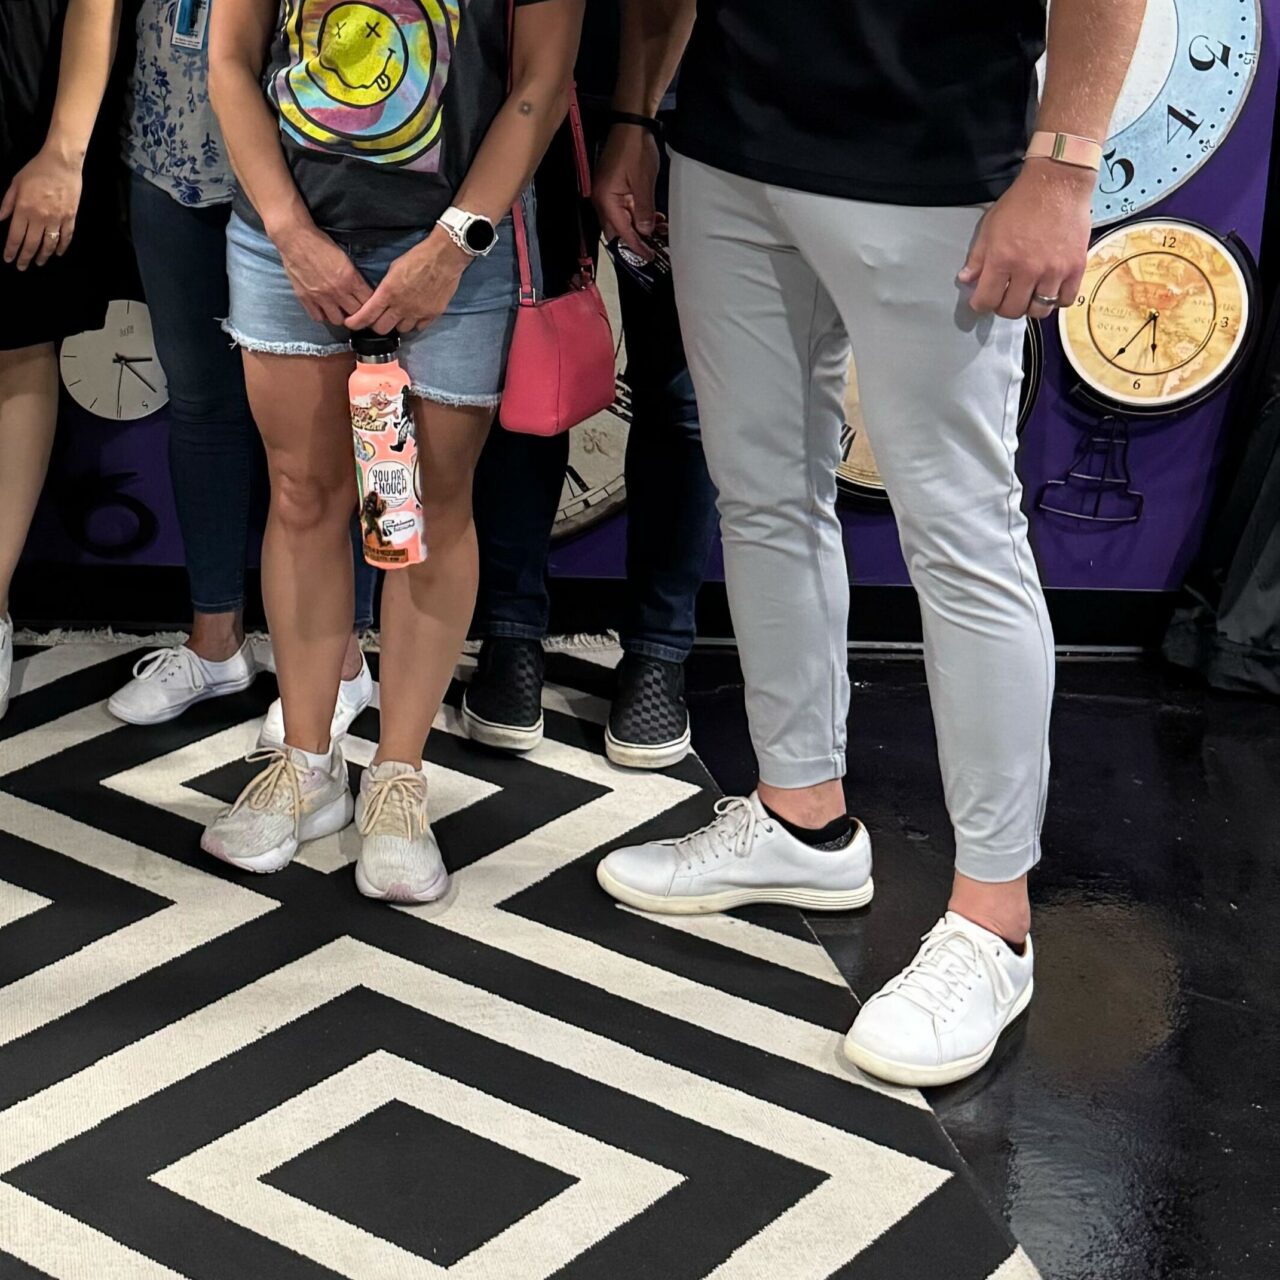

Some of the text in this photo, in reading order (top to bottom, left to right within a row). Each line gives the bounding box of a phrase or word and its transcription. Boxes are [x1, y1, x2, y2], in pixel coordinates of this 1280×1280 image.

[1188, 34, 1232, 72] 3
[1243, 50, 1258, 66] 15
[1166, 103, 1206, 145] 4
[1098, 147, 1135, 195] 5
[1120, 200, 1137, 215] 25
[1161, 235, 1177, 249] 12
[1077, 295, 1086, 307] 9
[1096, 323, 1130, 334] OCEAN
[1220, 316, 1230, 329] 3
[1132, 378, 1141, 391] 6
[372, 468, 405, 482] YOU ARE
